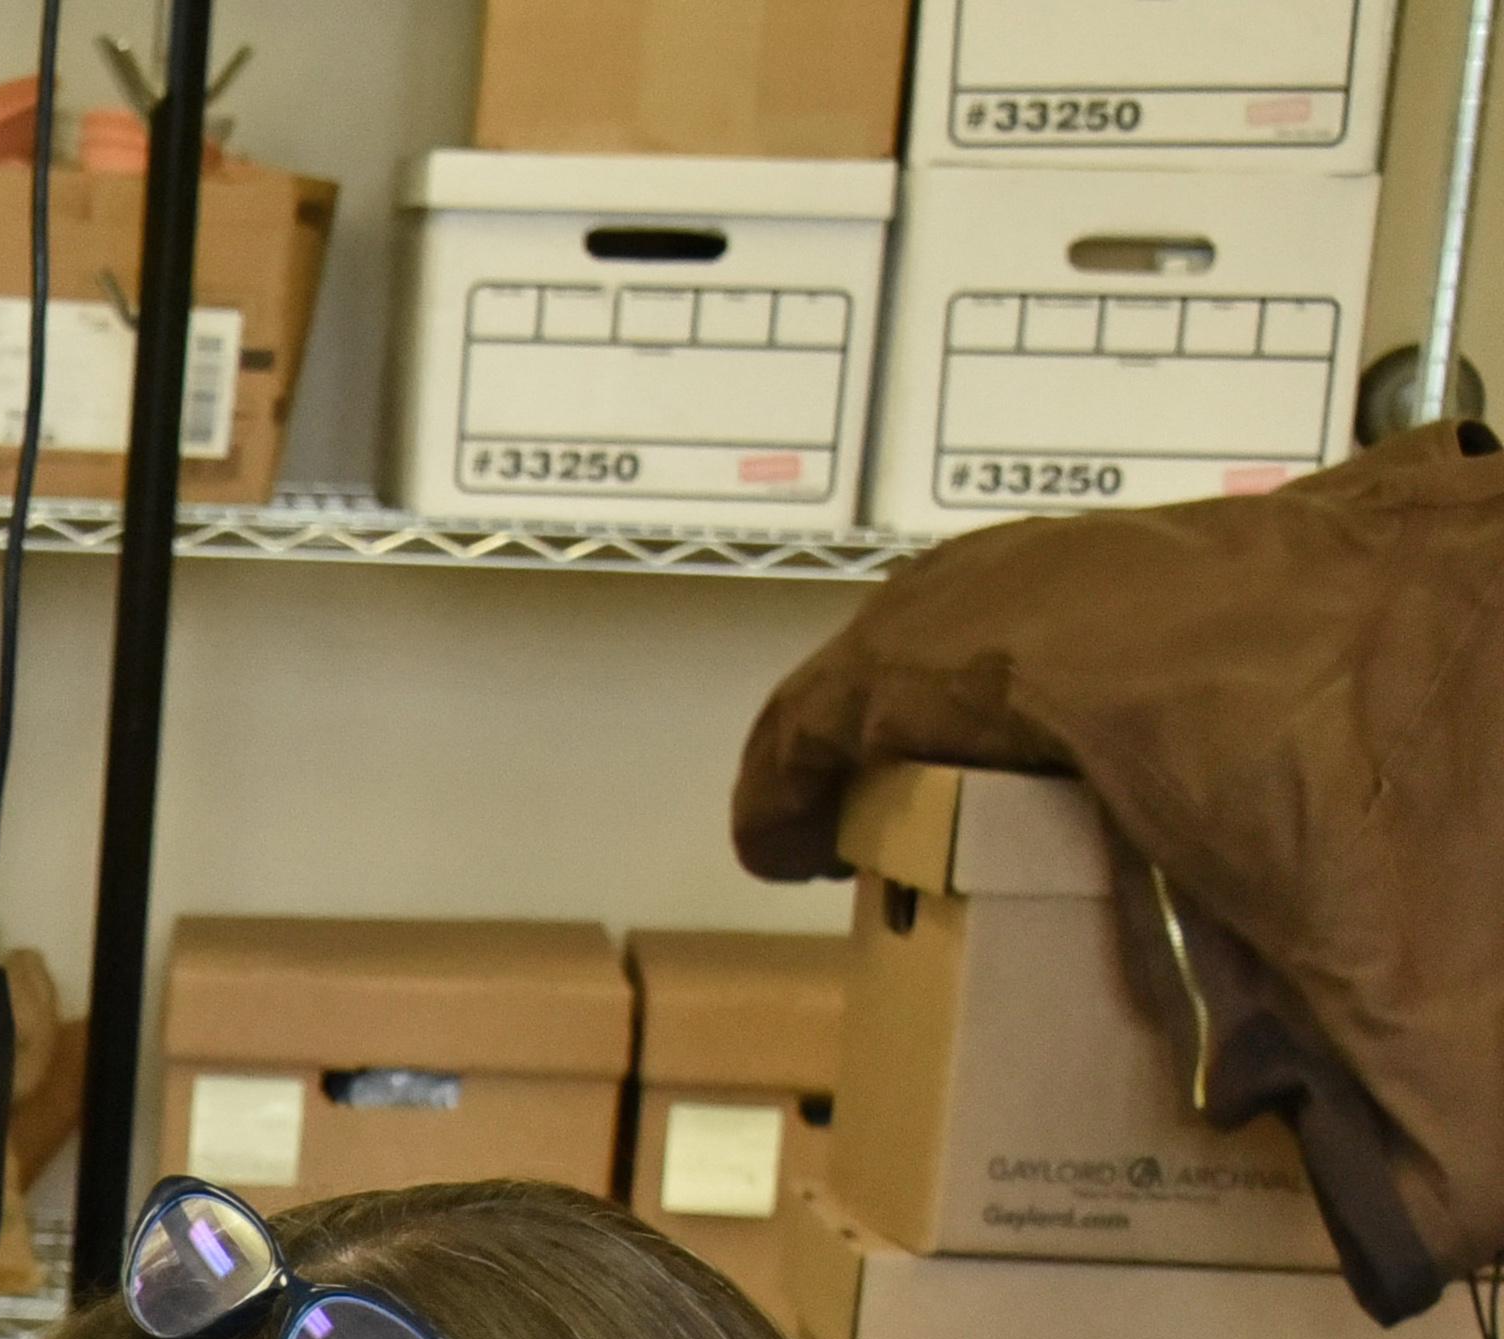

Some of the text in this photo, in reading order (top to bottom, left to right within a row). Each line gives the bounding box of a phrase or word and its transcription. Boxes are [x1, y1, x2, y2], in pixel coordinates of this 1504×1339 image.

[965, 99, 1142, 132] #33250
[473, 448, 642, 484] #33250
[950, 464, 1123, 496] #33250
[988, 1156, 1116, 1184] GAYLORD
